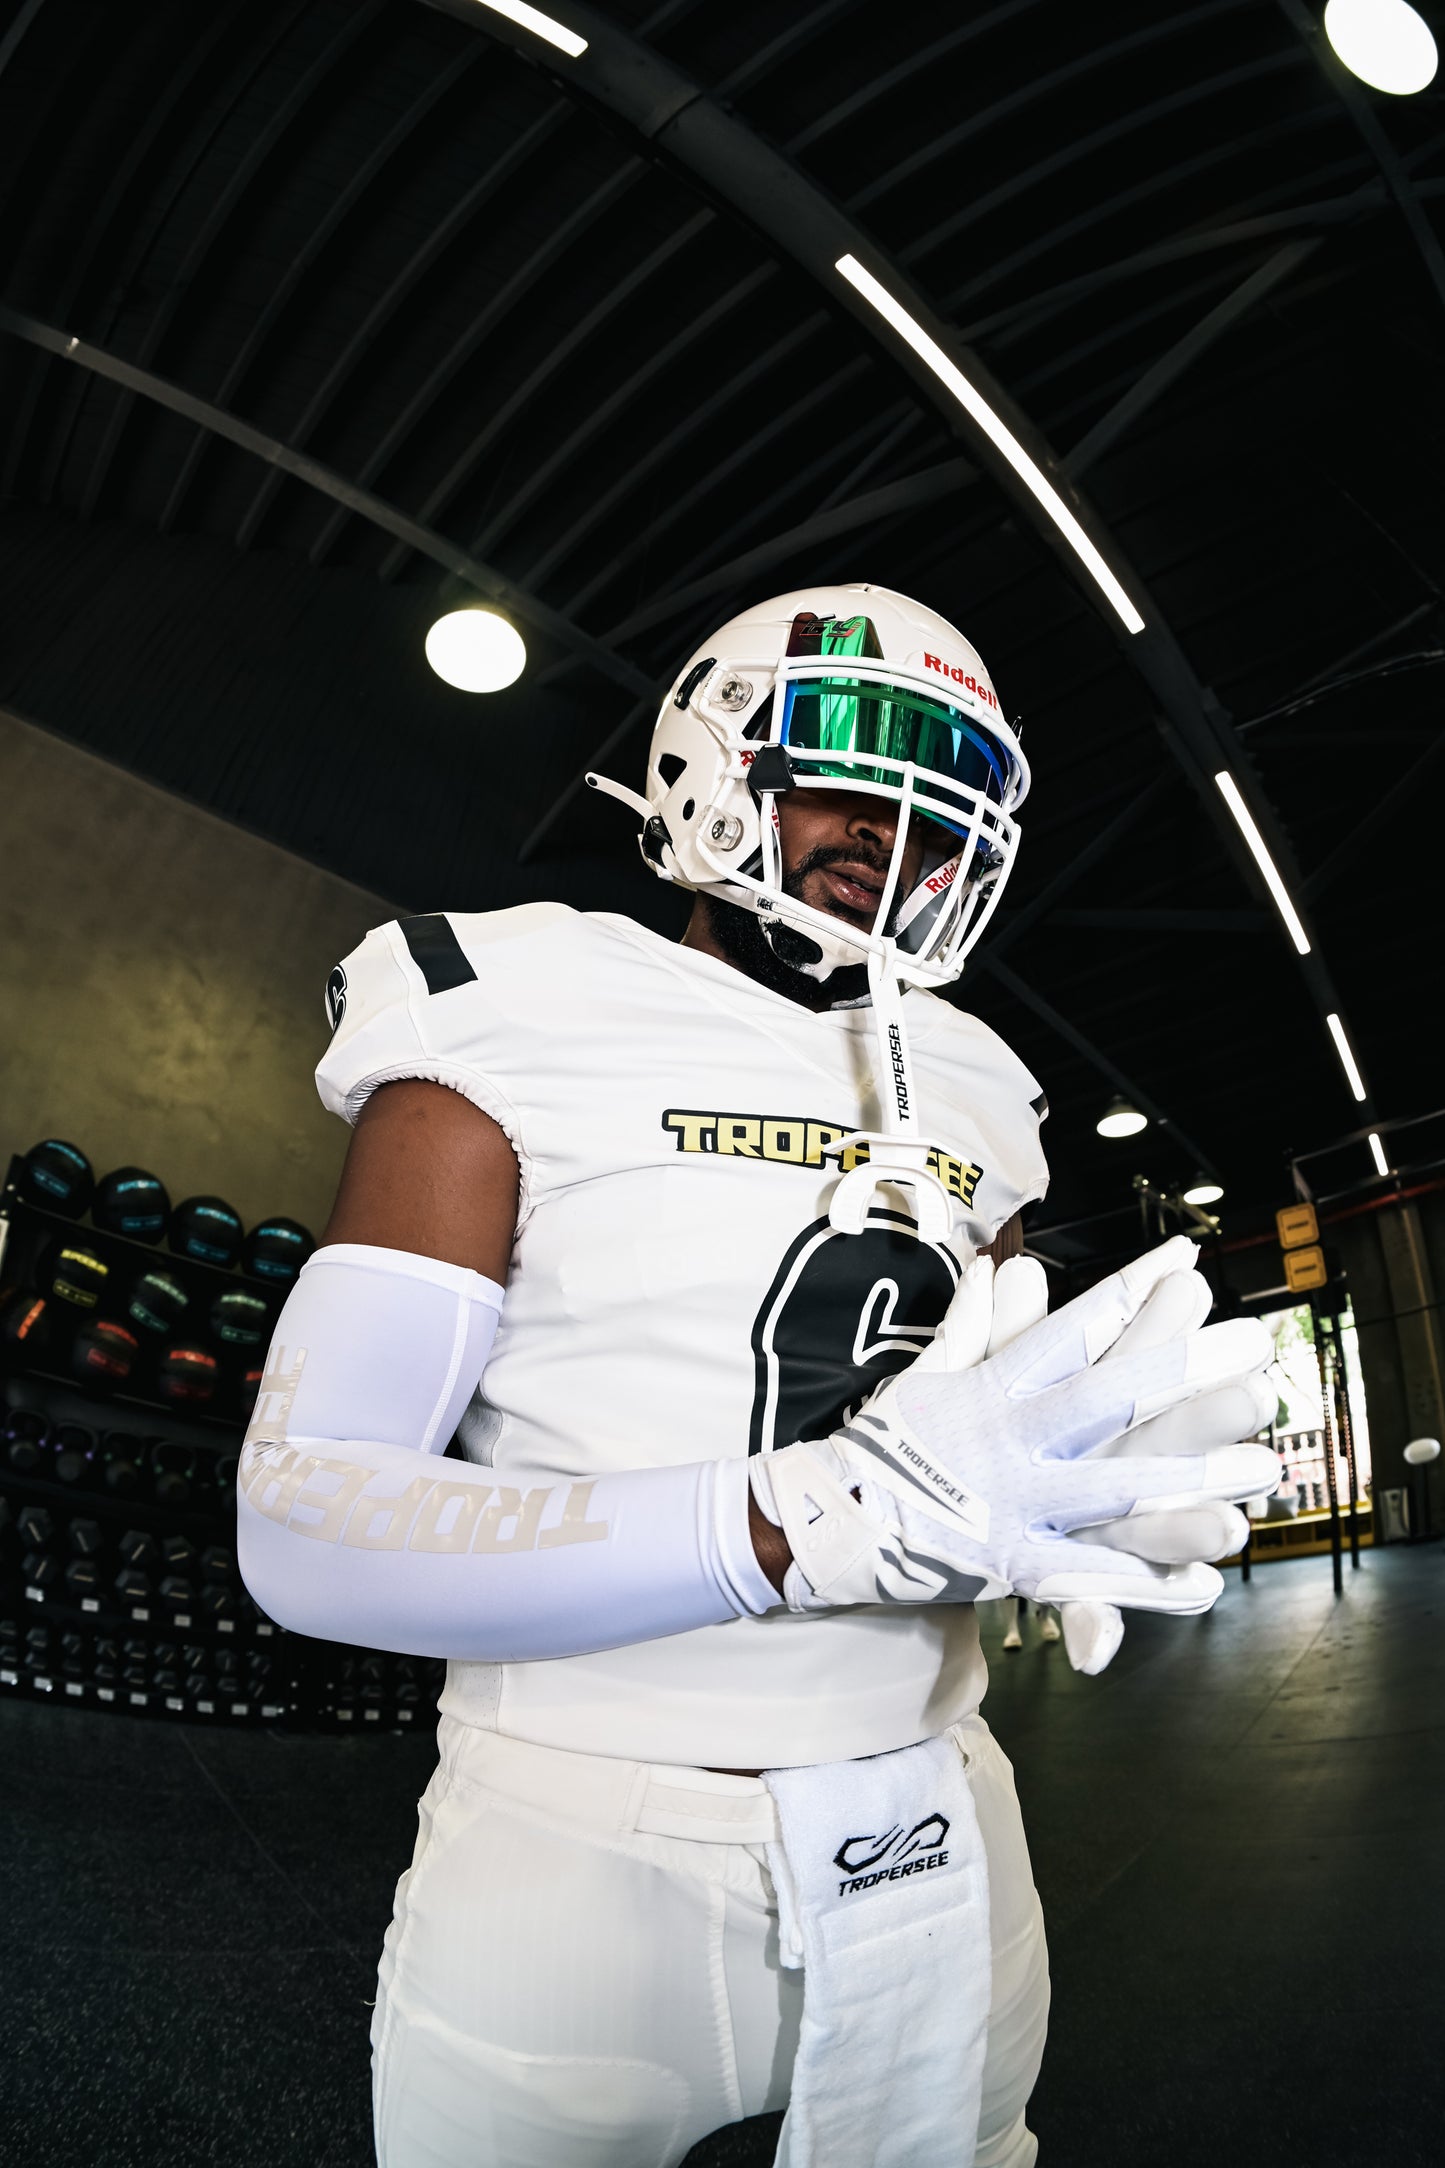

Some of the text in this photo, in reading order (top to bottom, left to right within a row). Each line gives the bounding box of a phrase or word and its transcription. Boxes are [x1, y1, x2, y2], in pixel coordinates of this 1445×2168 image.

[923, 651, 998, 711] Riddell
[924, 863, 961, 894] Ridd
[662, 1108, 984, 1210] TROPEEE
[897, 1438, 970, 1508] TROPERSEE
[838, 1850, 949, 1897] TROPERSEE
